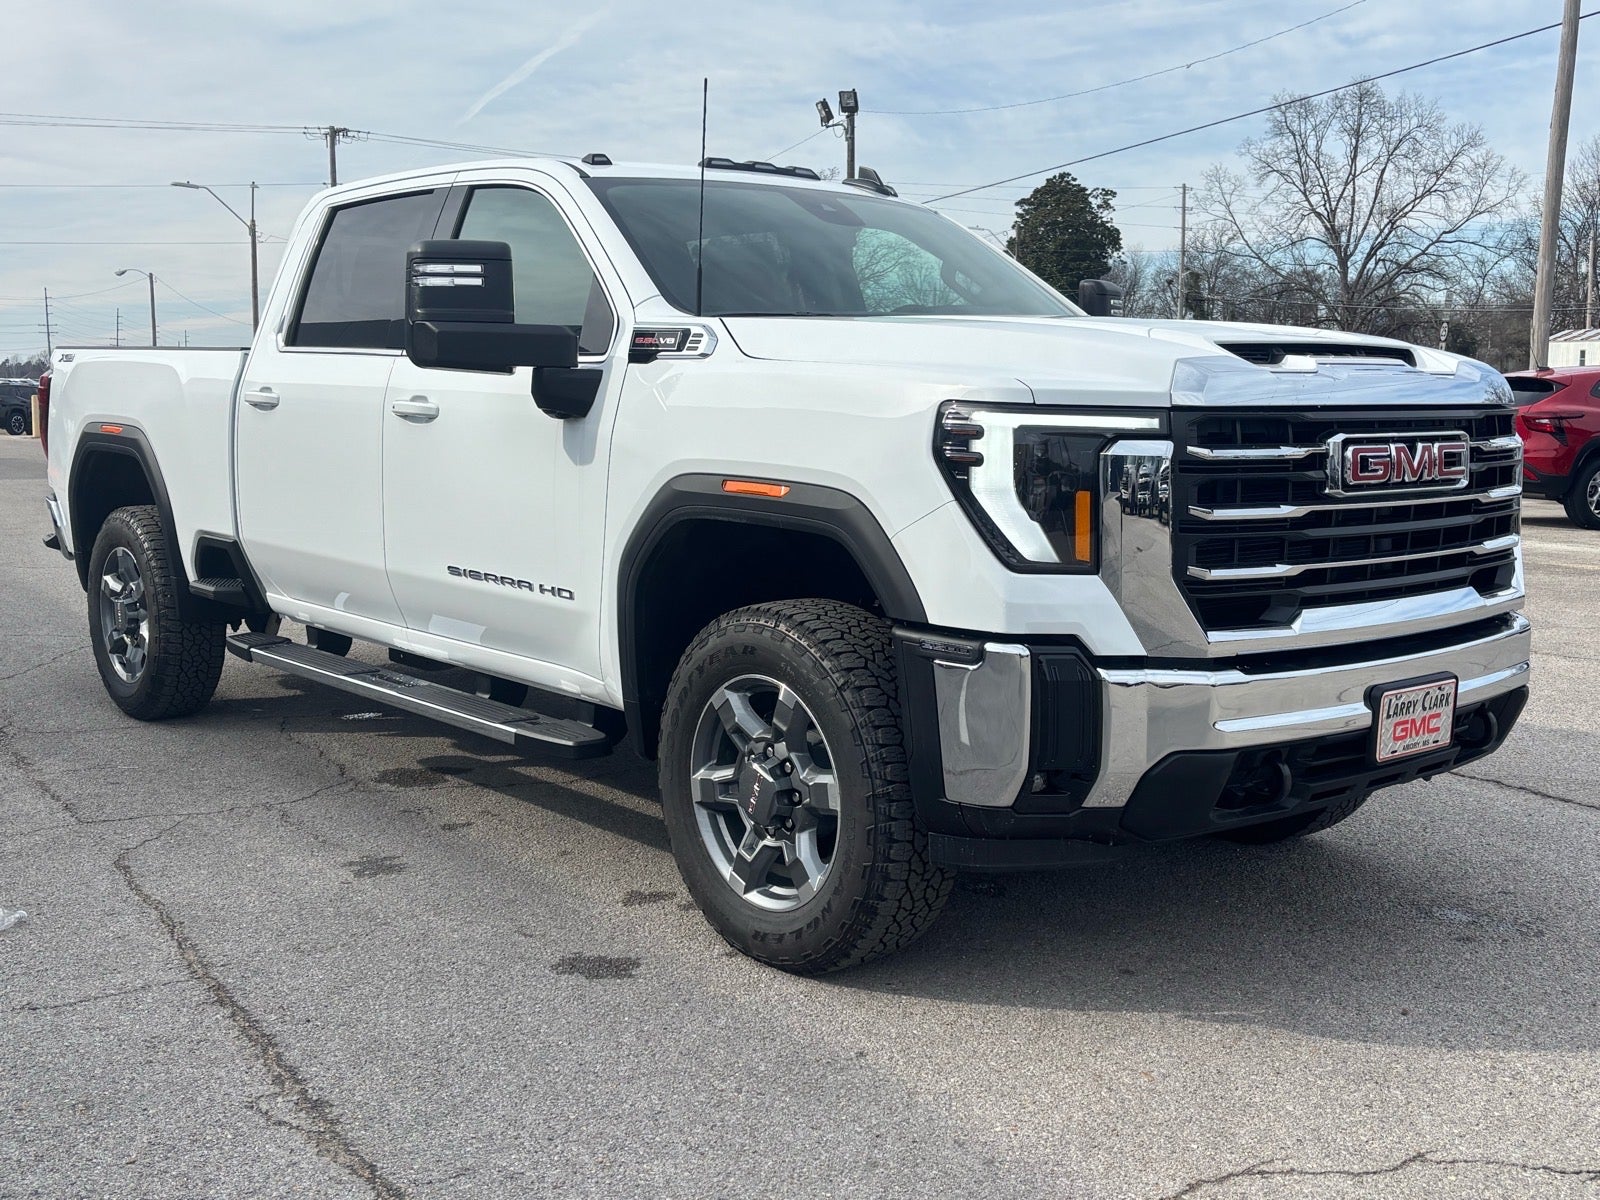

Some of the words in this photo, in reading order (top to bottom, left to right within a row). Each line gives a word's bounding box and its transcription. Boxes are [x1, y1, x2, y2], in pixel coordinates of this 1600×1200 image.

[1344, 442, 1467, 485] GMC
[446, 565, 535, 592] SIERRA
[538, 583, 575, 601] HD
[1386, 699, 1418, 719] LARRY
[1422, 691, 1451, 711] CLARK
[1392, 713, 1441, 742] GMC
